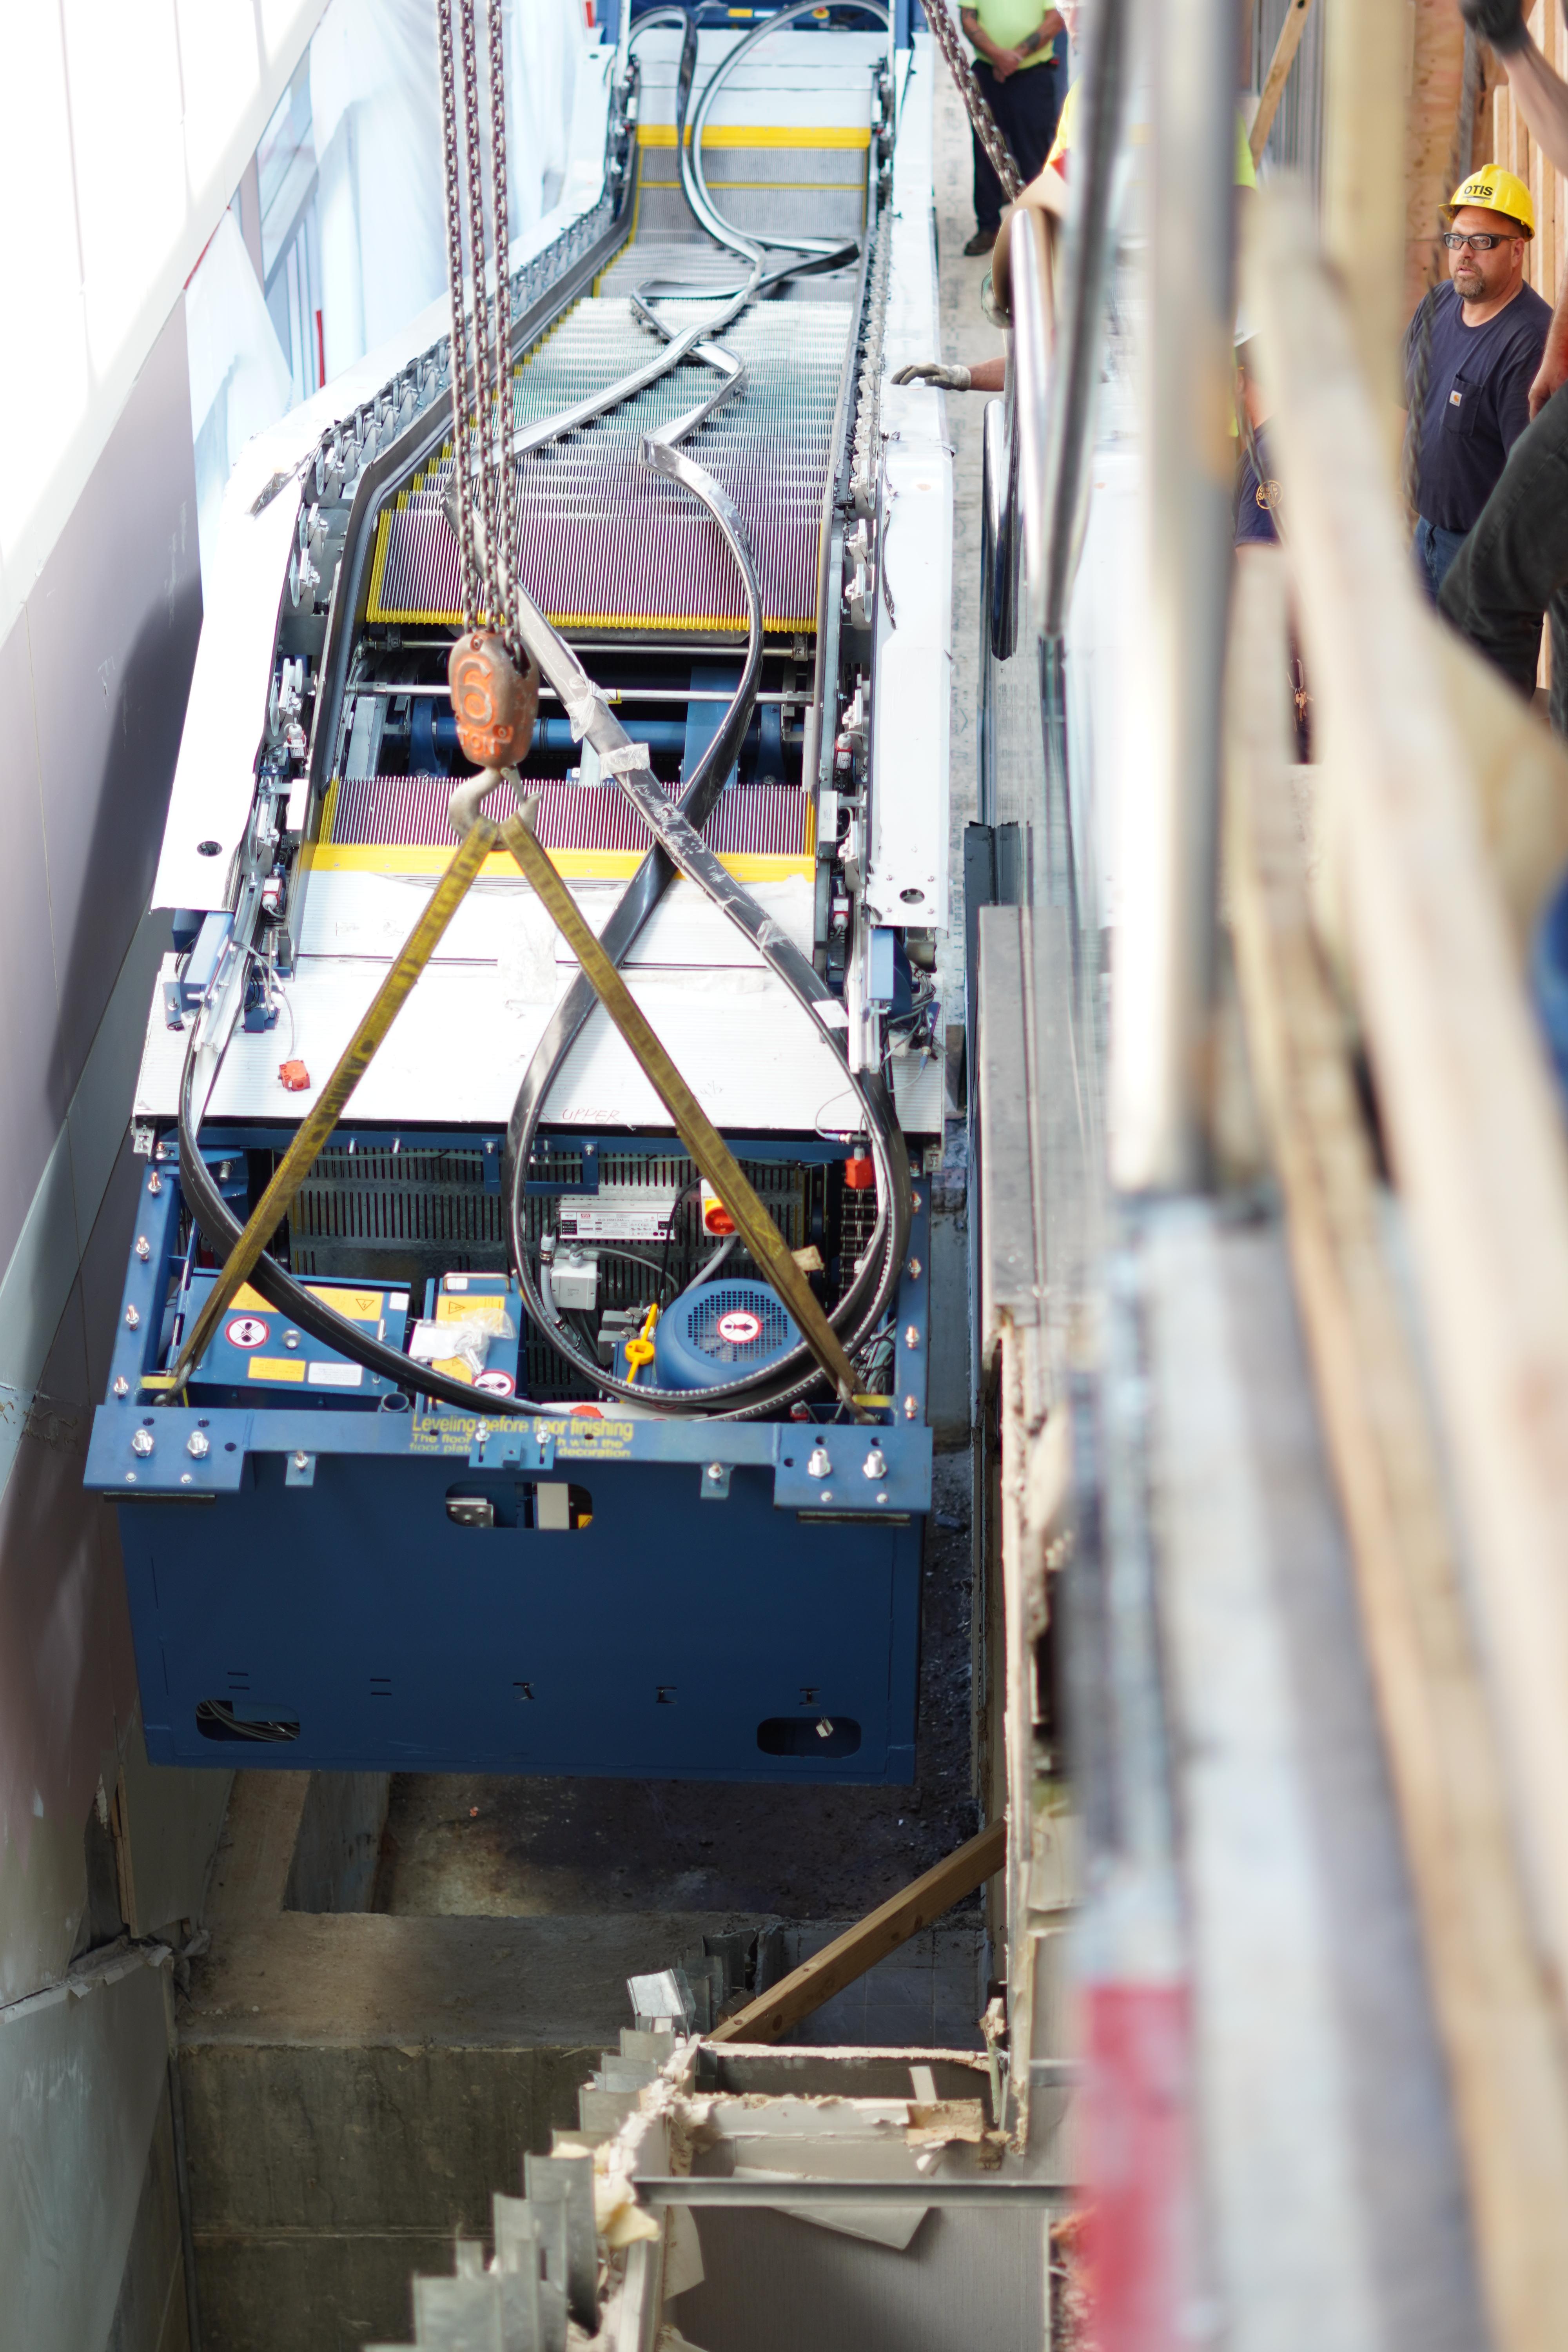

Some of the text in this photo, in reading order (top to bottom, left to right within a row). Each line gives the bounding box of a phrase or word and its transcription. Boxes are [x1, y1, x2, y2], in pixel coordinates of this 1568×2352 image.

[1464, 185, 1494, 196] OTIS
[456, 657, 494, 727] 6
[456, 724, 496, 755] TON
[562, 1108, 620, 1123] UPPER
[413, 1414, 476, 1437] Leveling
[571, 1417, 633, 1442] finishing
[413, 1433, 472, 1444] The floor
[602, 1439, 624, 1449] the
[410, 1442, 439, 1451] floor
[559, 1446, 631, 1458] decoration
